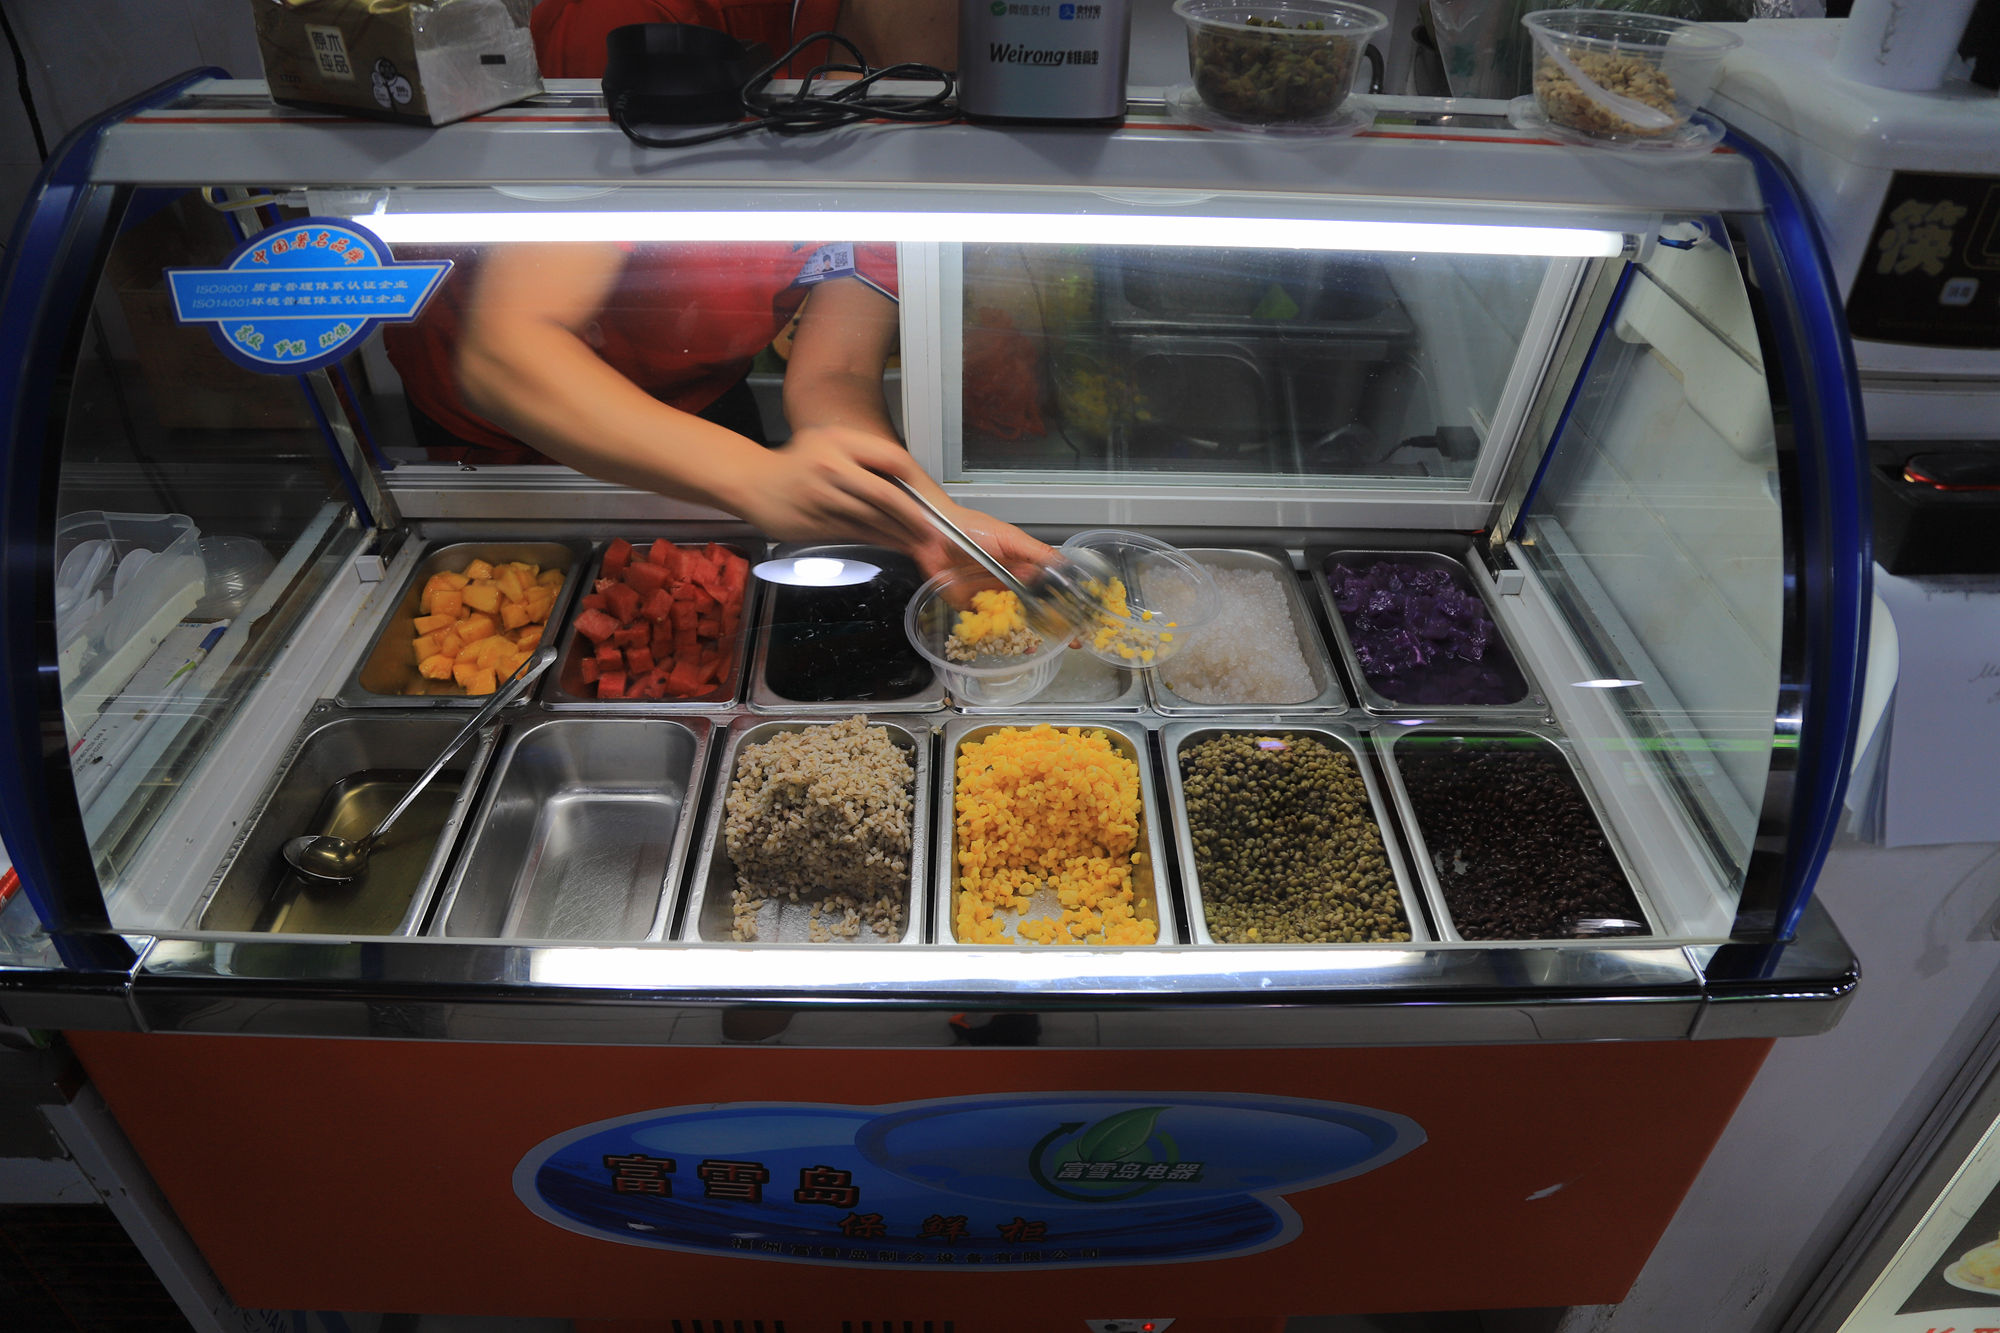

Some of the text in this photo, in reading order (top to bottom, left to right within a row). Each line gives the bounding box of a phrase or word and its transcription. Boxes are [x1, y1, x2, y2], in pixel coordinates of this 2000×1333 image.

[1008, 4, 1050, 16] 微信支付
[1076, 4, 1101, 15] 支付宝
[312, 32, 343, 51] 原木
[319, 53, 350, 74] 纯品
[989, 43, 1065, 67] Weirong
[253, 231, 365, 265] 中国著名品牌
[1877, 199, 1968, 276] 筷
[196, 284, 249, 295] ISO9001
[603, 1154, 860, 1208] 富雪岛
[1056, 1161, 1201, 1181] 富雪岛电器
[837, 1213, 1048, 1245] 保鲜柜
